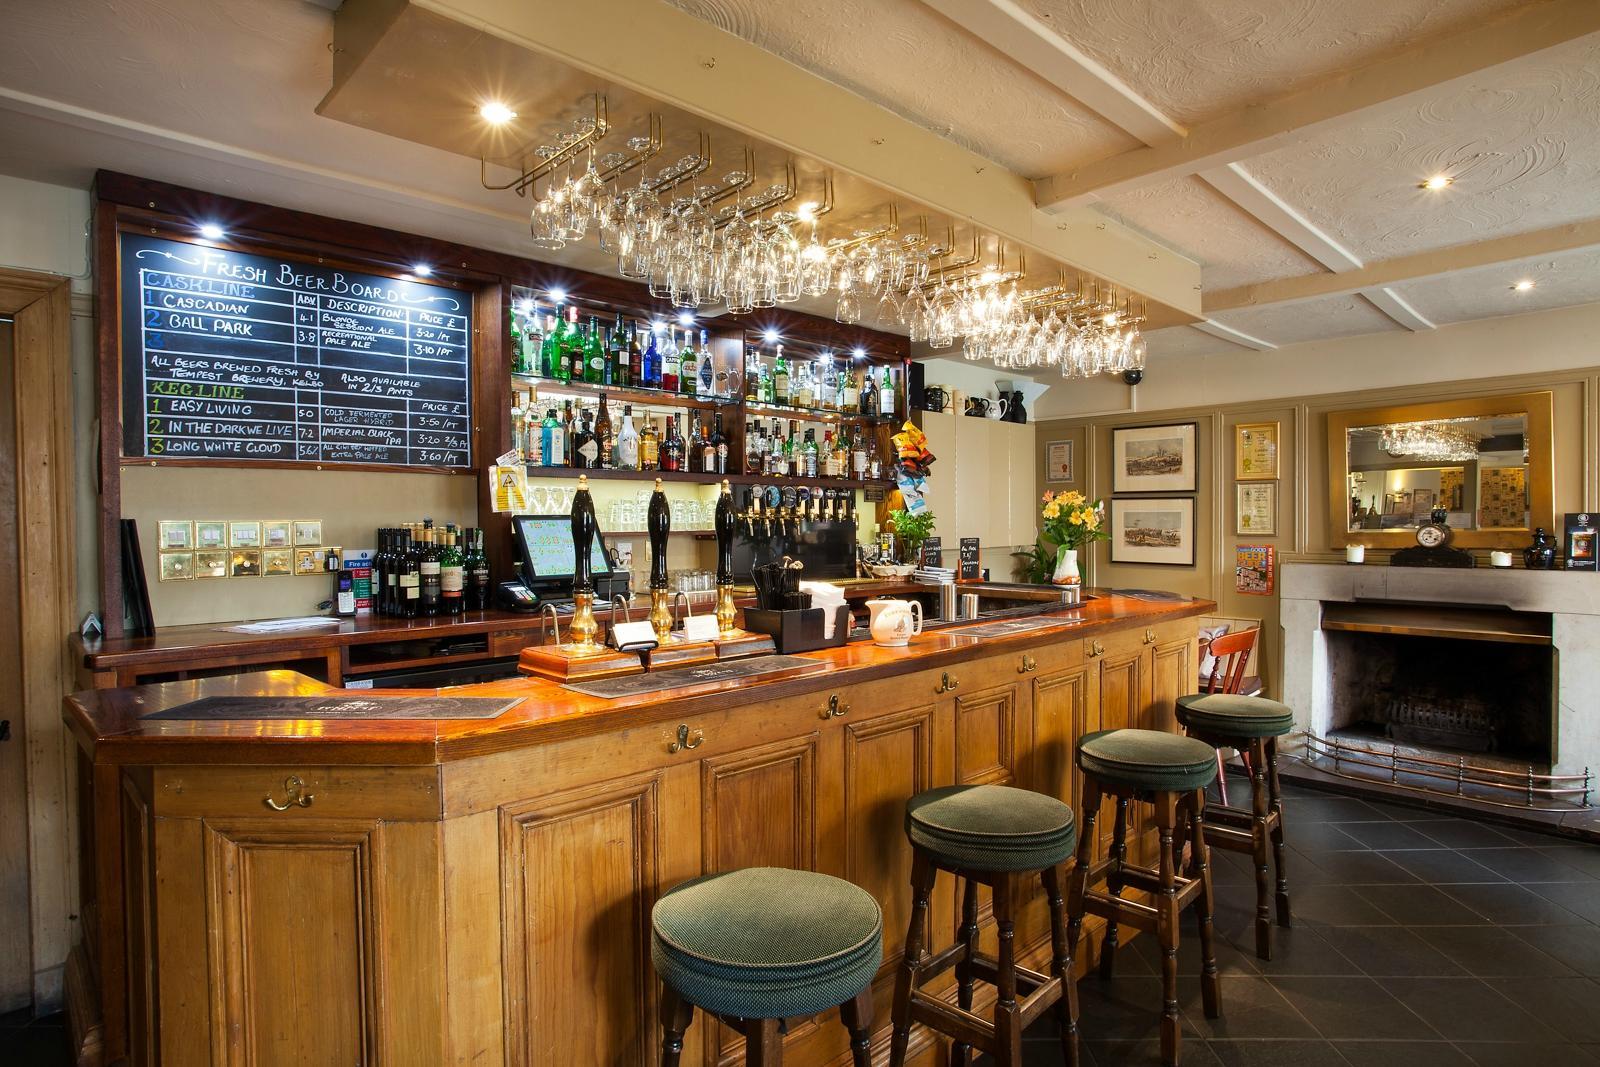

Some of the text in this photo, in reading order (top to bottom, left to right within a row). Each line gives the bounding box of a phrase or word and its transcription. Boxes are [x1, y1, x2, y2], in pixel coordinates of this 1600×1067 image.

[202, 252, 267, 283] FRESH
[276, 264, 329, 290] BEER
[146, 290, 154, 305] 1
[163, 294, 249, 314] CASCADIAN
[327, 299, 402, 319] DESCRIPTION
[147, 310, 163, 327] 2
[169, 313, 252, 336] BALL PARK
[322, 312, 359, 325] BLONDE
[419, 312, 456, 328] PRICE £
[334, 322, 396, 335] SESSION ALE
[415, 328, 435, 339] 3.20
[298, 330, 316, 343] 3.8
[321, 330, 378, 343] RECREATIONAL
[325, 336, 372, 349] PALE ALE
[414, 343, 435, 355] 3.10
[151, 355, 320, 380] ALL BEERS BREWED FRESH BY
[169, 368, 224, 382] TEMPEST
[341, 373, 422, 389] ALSO AVAILABLE
[151, 380, 245, 400] KEG LINE
[348, 383, 414, 397] IN 2/3 PINTS
[150, 398, 162, 414] 1
[170, 400, 252, 415] EASY LIVING
[422, 402, 460, 414] PRICE £
[324, 409, 345, 417] COLD
[334, 415, 359, 425] LAGER
[418, 417, 440, 427] 3.50
[149, 419, 164, 435] 2
[168, 421, 182, 434] IN
[185, 422, 214, 435] THE
[266, 425, 293, 437] LIVE
[298, 428, 314, 439] 7.2
[322, 427, 394, 439] IMPERIAL BLACK
[150, 438, 165, 454] 3
[166, 440, 282, 453] LONG WHITE CLOUD
[385, 437, 402, 445] IPA
[417, 435, 440, 445] 3.20
[419, 451, 442, 462] 3.60
[1237, 552, 1266, 561] BEER
